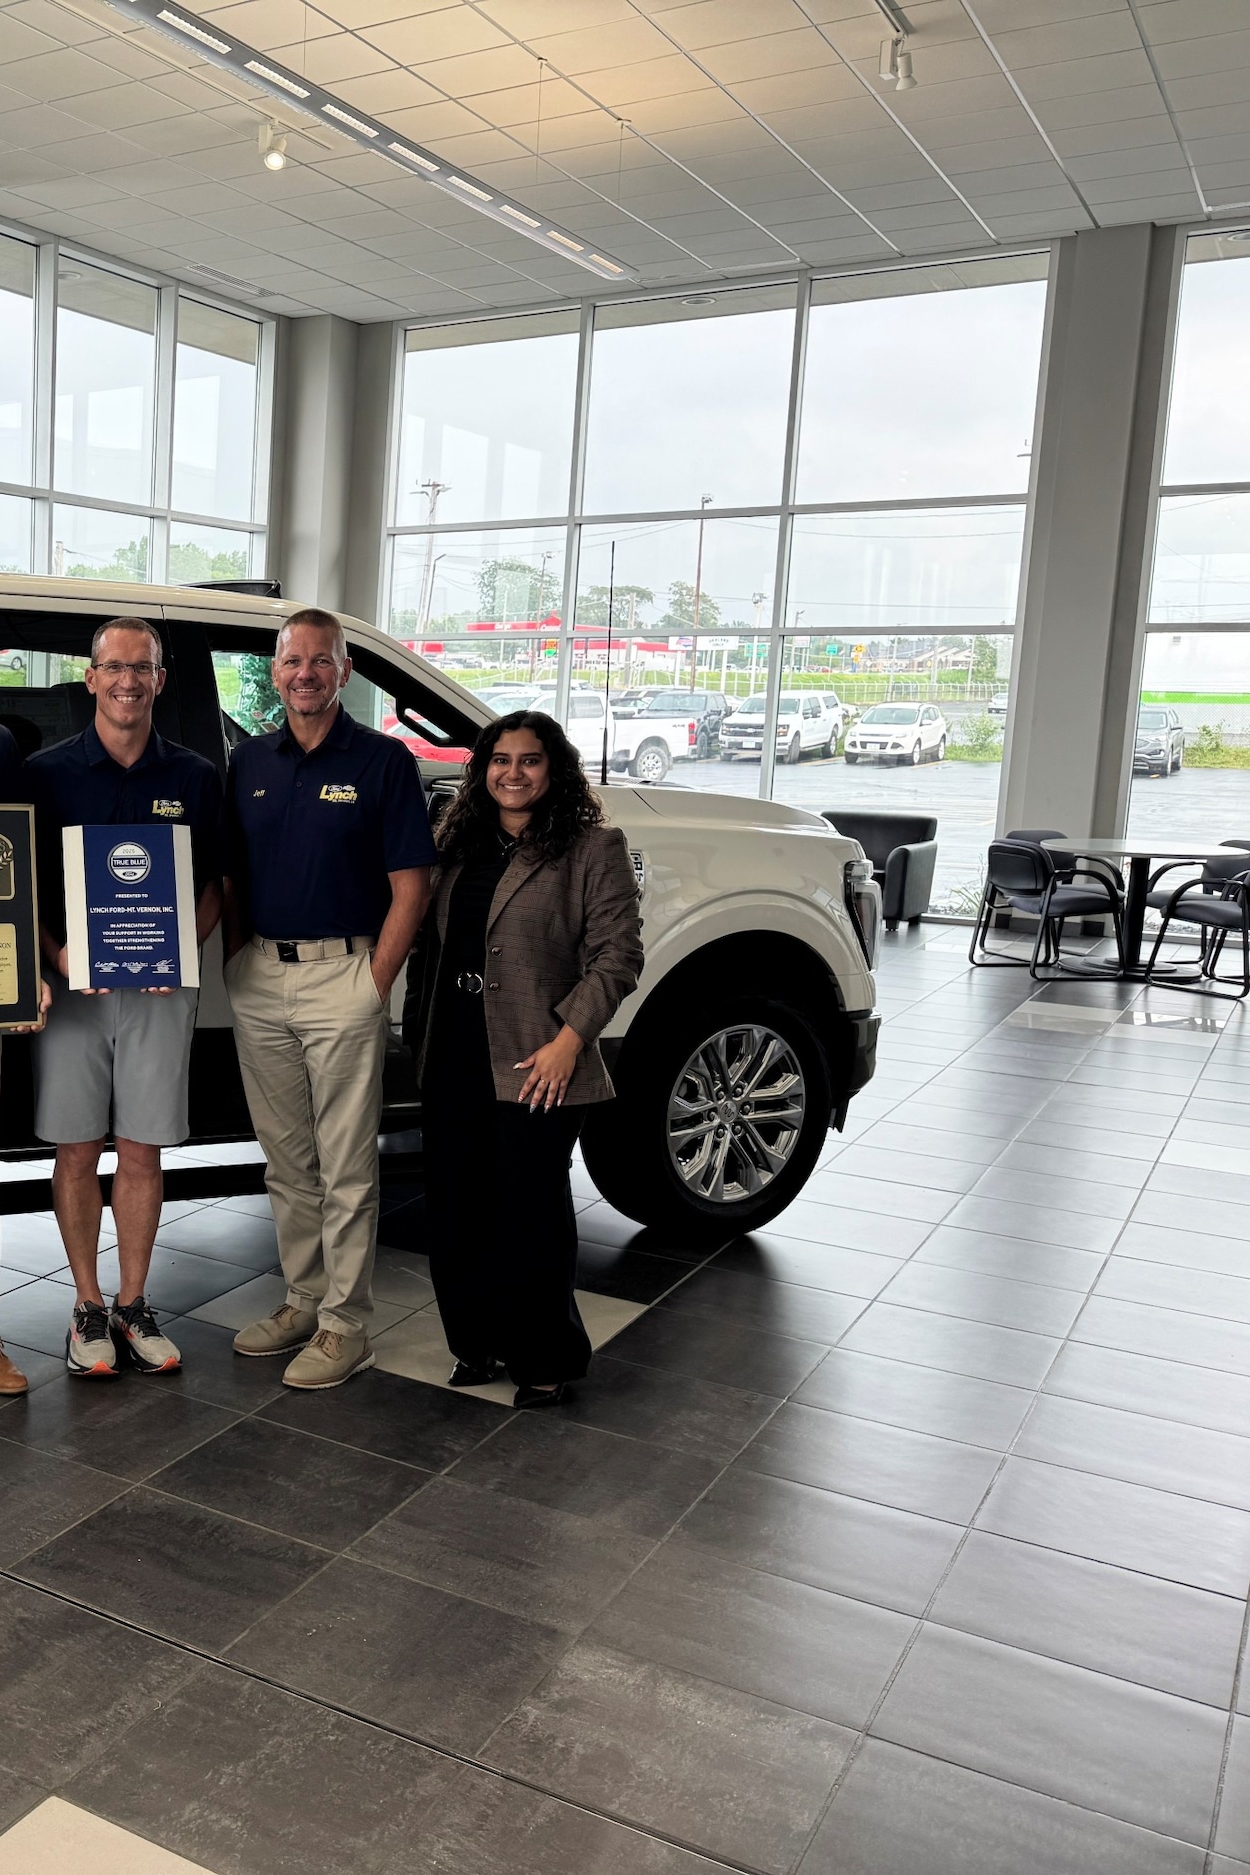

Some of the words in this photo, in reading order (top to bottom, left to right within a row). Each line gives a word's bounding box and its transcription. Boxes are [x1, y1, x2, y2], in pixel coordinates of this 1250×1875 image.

[253, 789, 266, 797] Jeff
[319, 785, 358, 801] Lynch
[152, 800, 184, 815] Lynch
